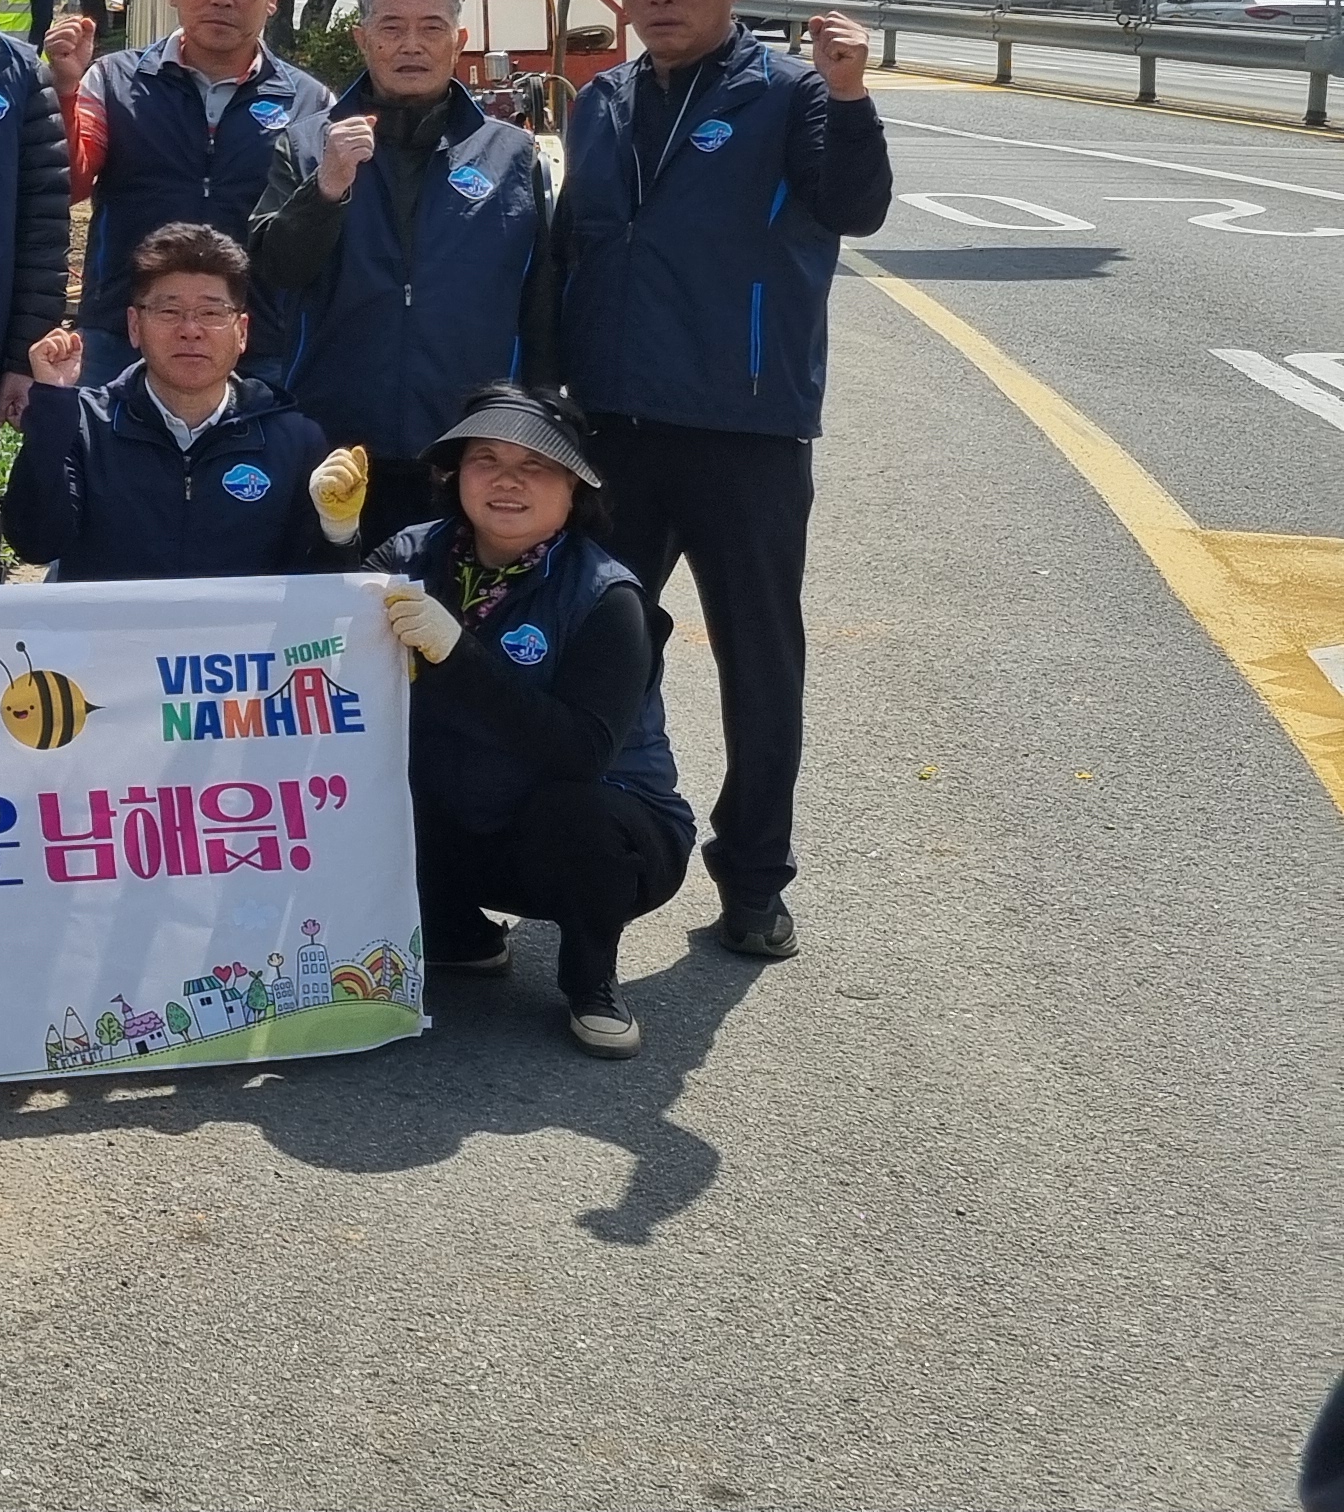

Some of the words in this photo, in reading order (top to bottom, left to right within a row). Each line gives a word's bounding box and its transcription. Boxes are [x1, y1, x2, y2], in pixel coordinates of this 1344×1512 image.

[283, 635, 346, 666] HOME
[155, 652, 276, 696] VISIT
[161, 668, 366, 742] NAMHAE
